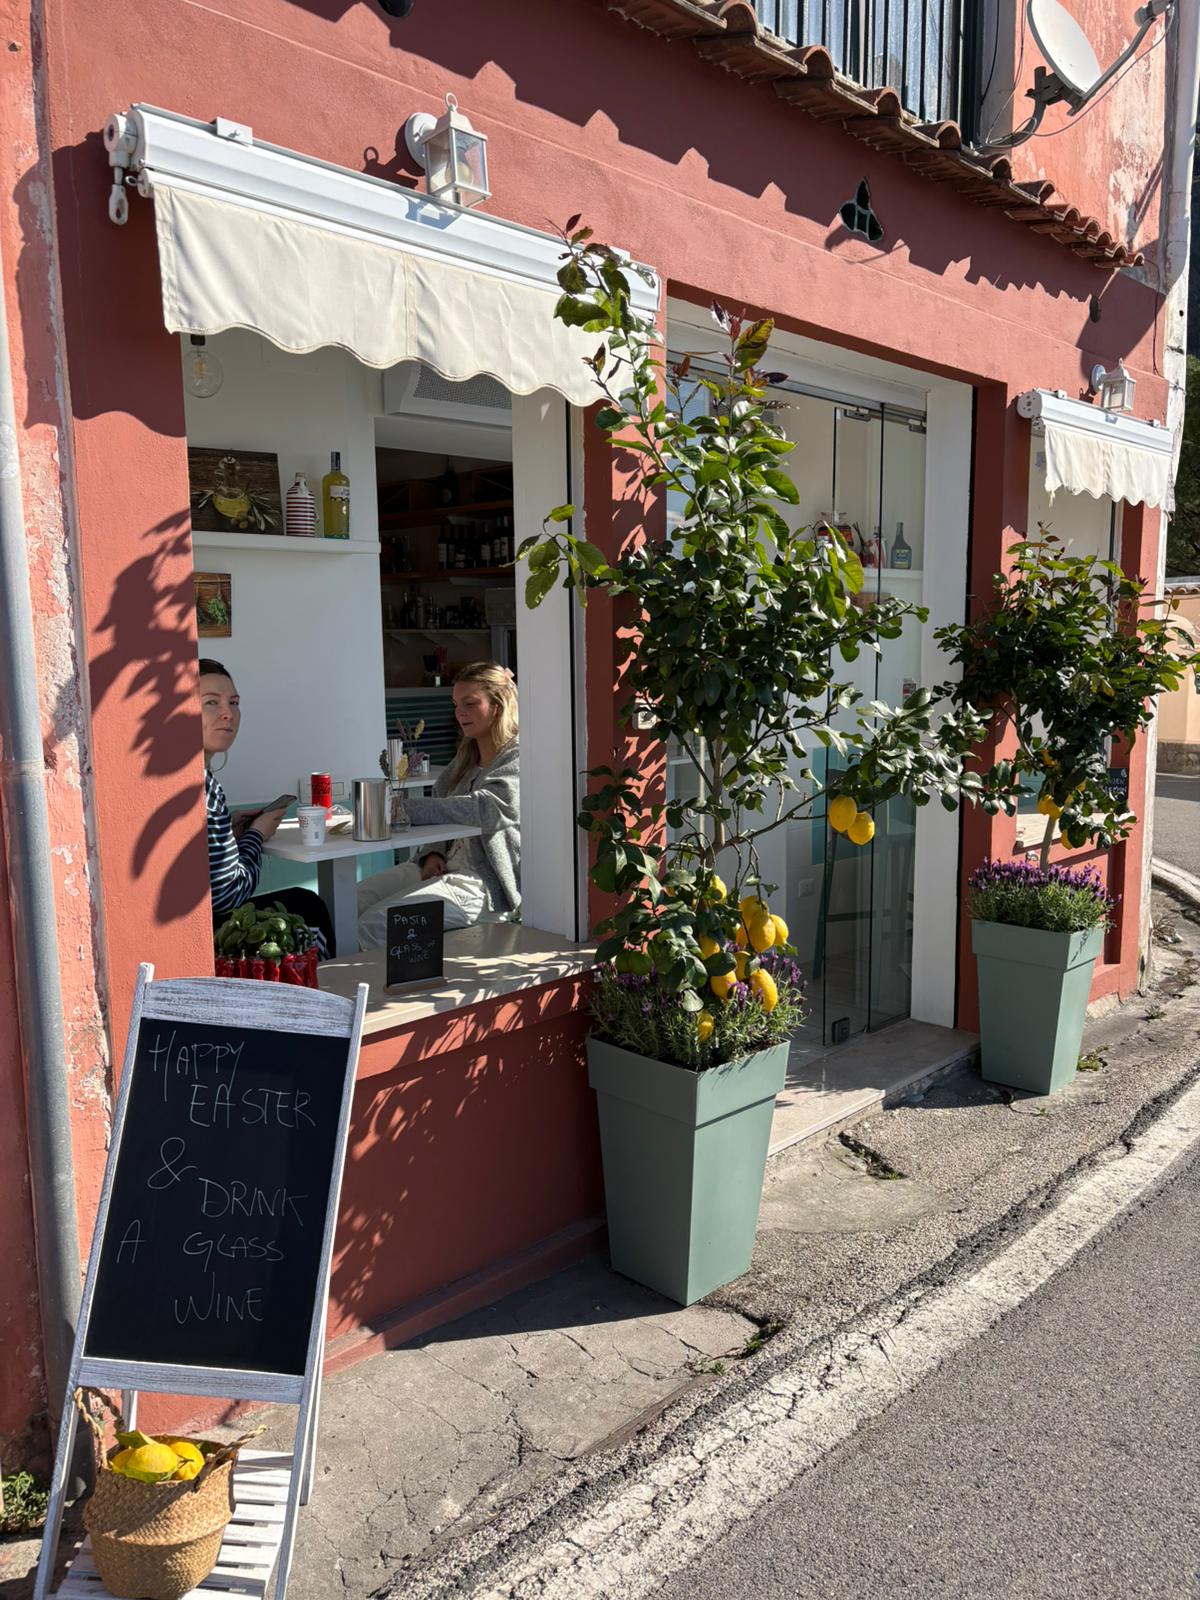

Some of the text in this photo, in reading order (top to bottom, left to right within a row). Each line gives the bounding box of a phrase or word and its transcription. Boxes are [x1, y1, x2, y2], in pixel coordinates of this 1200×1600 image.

[393, 913, 427, 926] PASTA
[149, 1030, 245, 1101] HAPPY
[189, 1083, 317, 1128] EASTER
[147, 1136, 198, 1190] &
[198, 1177, 308, 1227] DRINK
[116, 1219, 285, 1272] A GLASS
[174, 1272, 264, 1324] WINE
